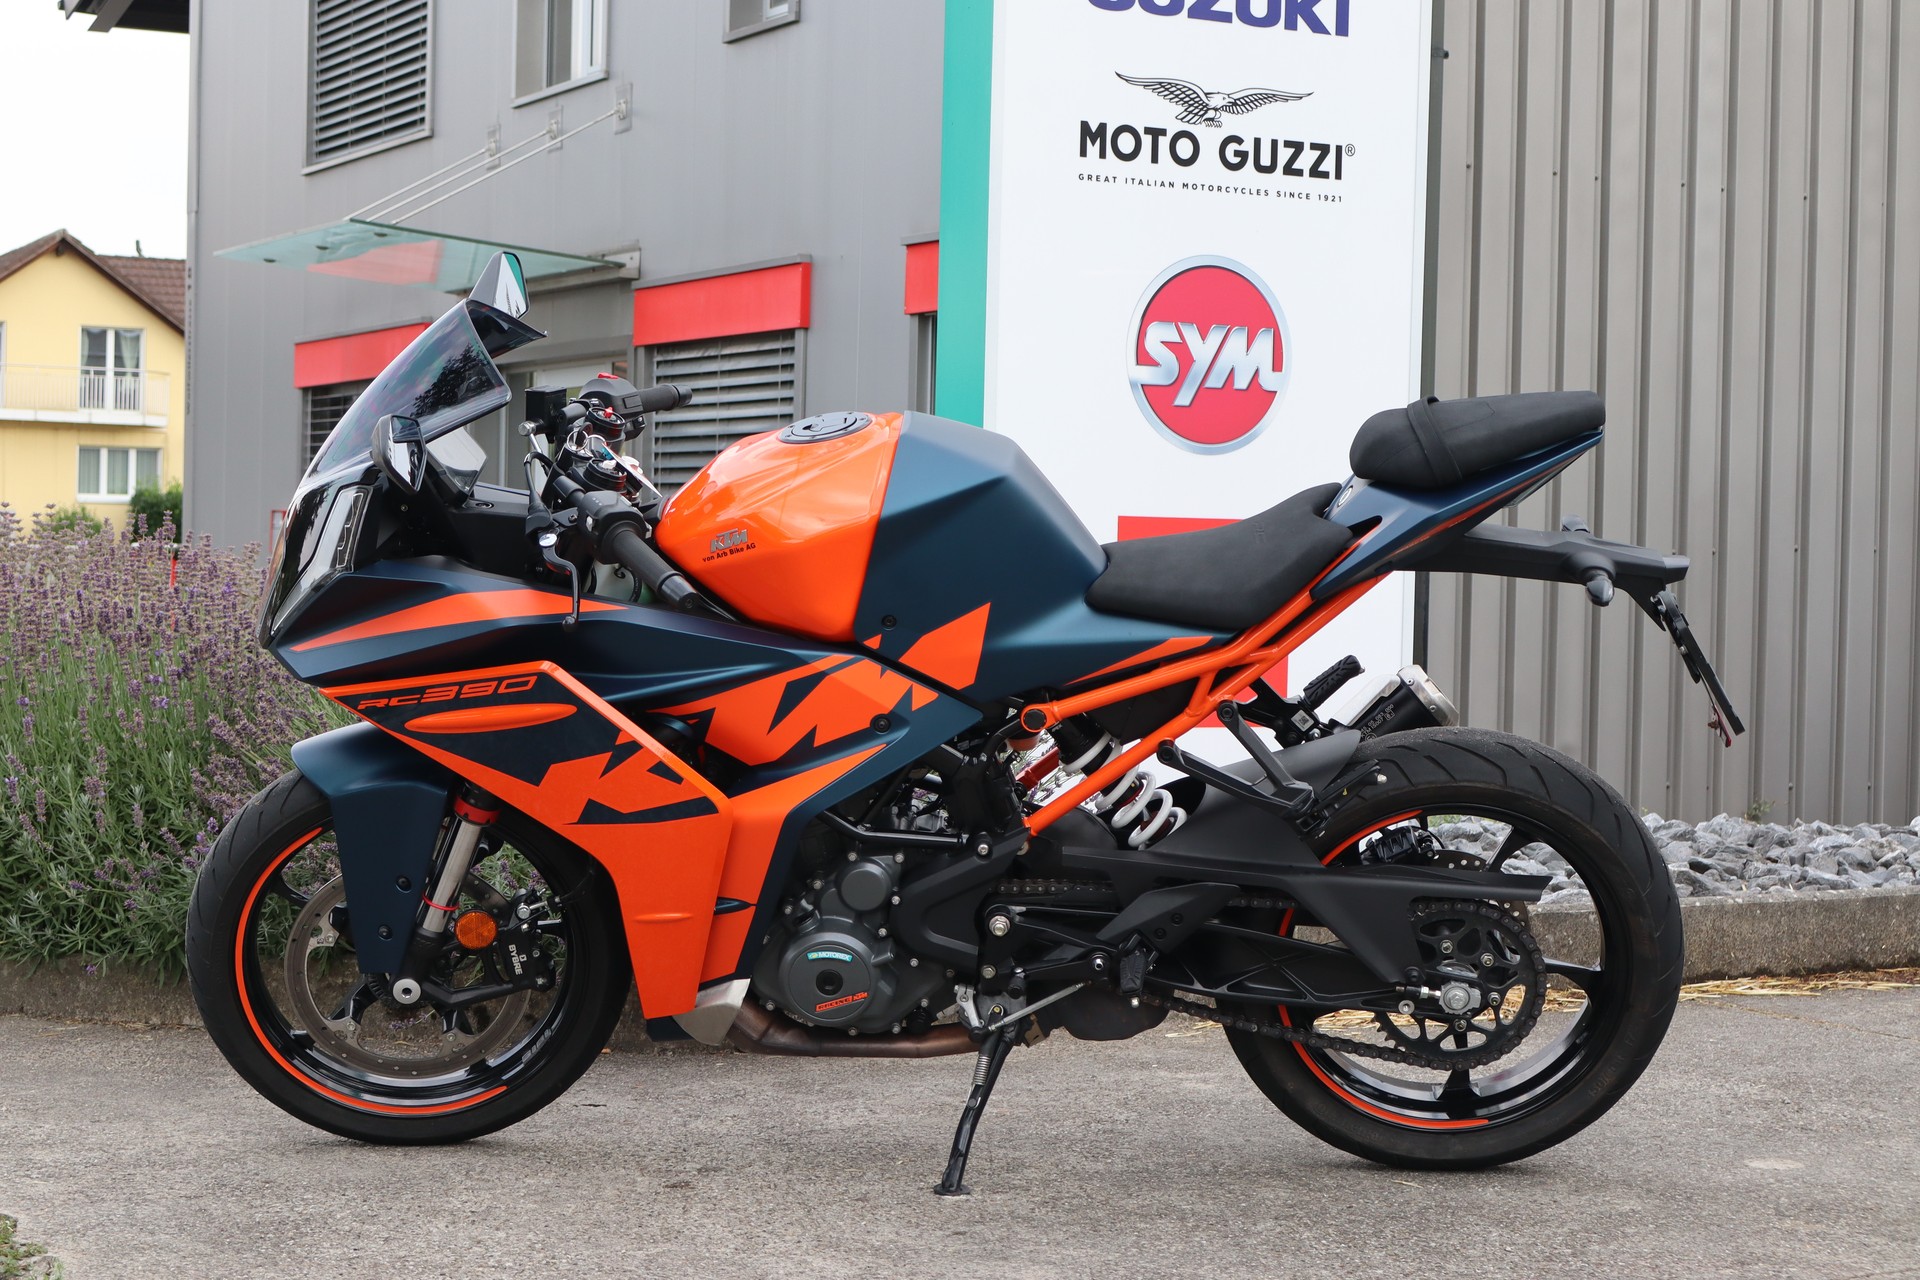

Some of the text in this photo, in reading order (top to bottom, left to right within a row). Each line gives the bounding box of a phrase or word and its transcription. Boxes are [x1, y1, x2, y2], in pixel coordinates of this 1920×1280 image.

[1079, 120, 1200, 167] MOTO
[1078, 173, 1342, 203] GREAT ITALIAN MOTORCYCLES SINCE 1921
[1133, 321, 1283, 407] SYM
[702, 542, 756, 562] von Arb Bike AG
[710, 528, 747, 552] KTM
[509, 945, 523, 975] BYBRE
[818, 951, 850, 961] MOTOREX
